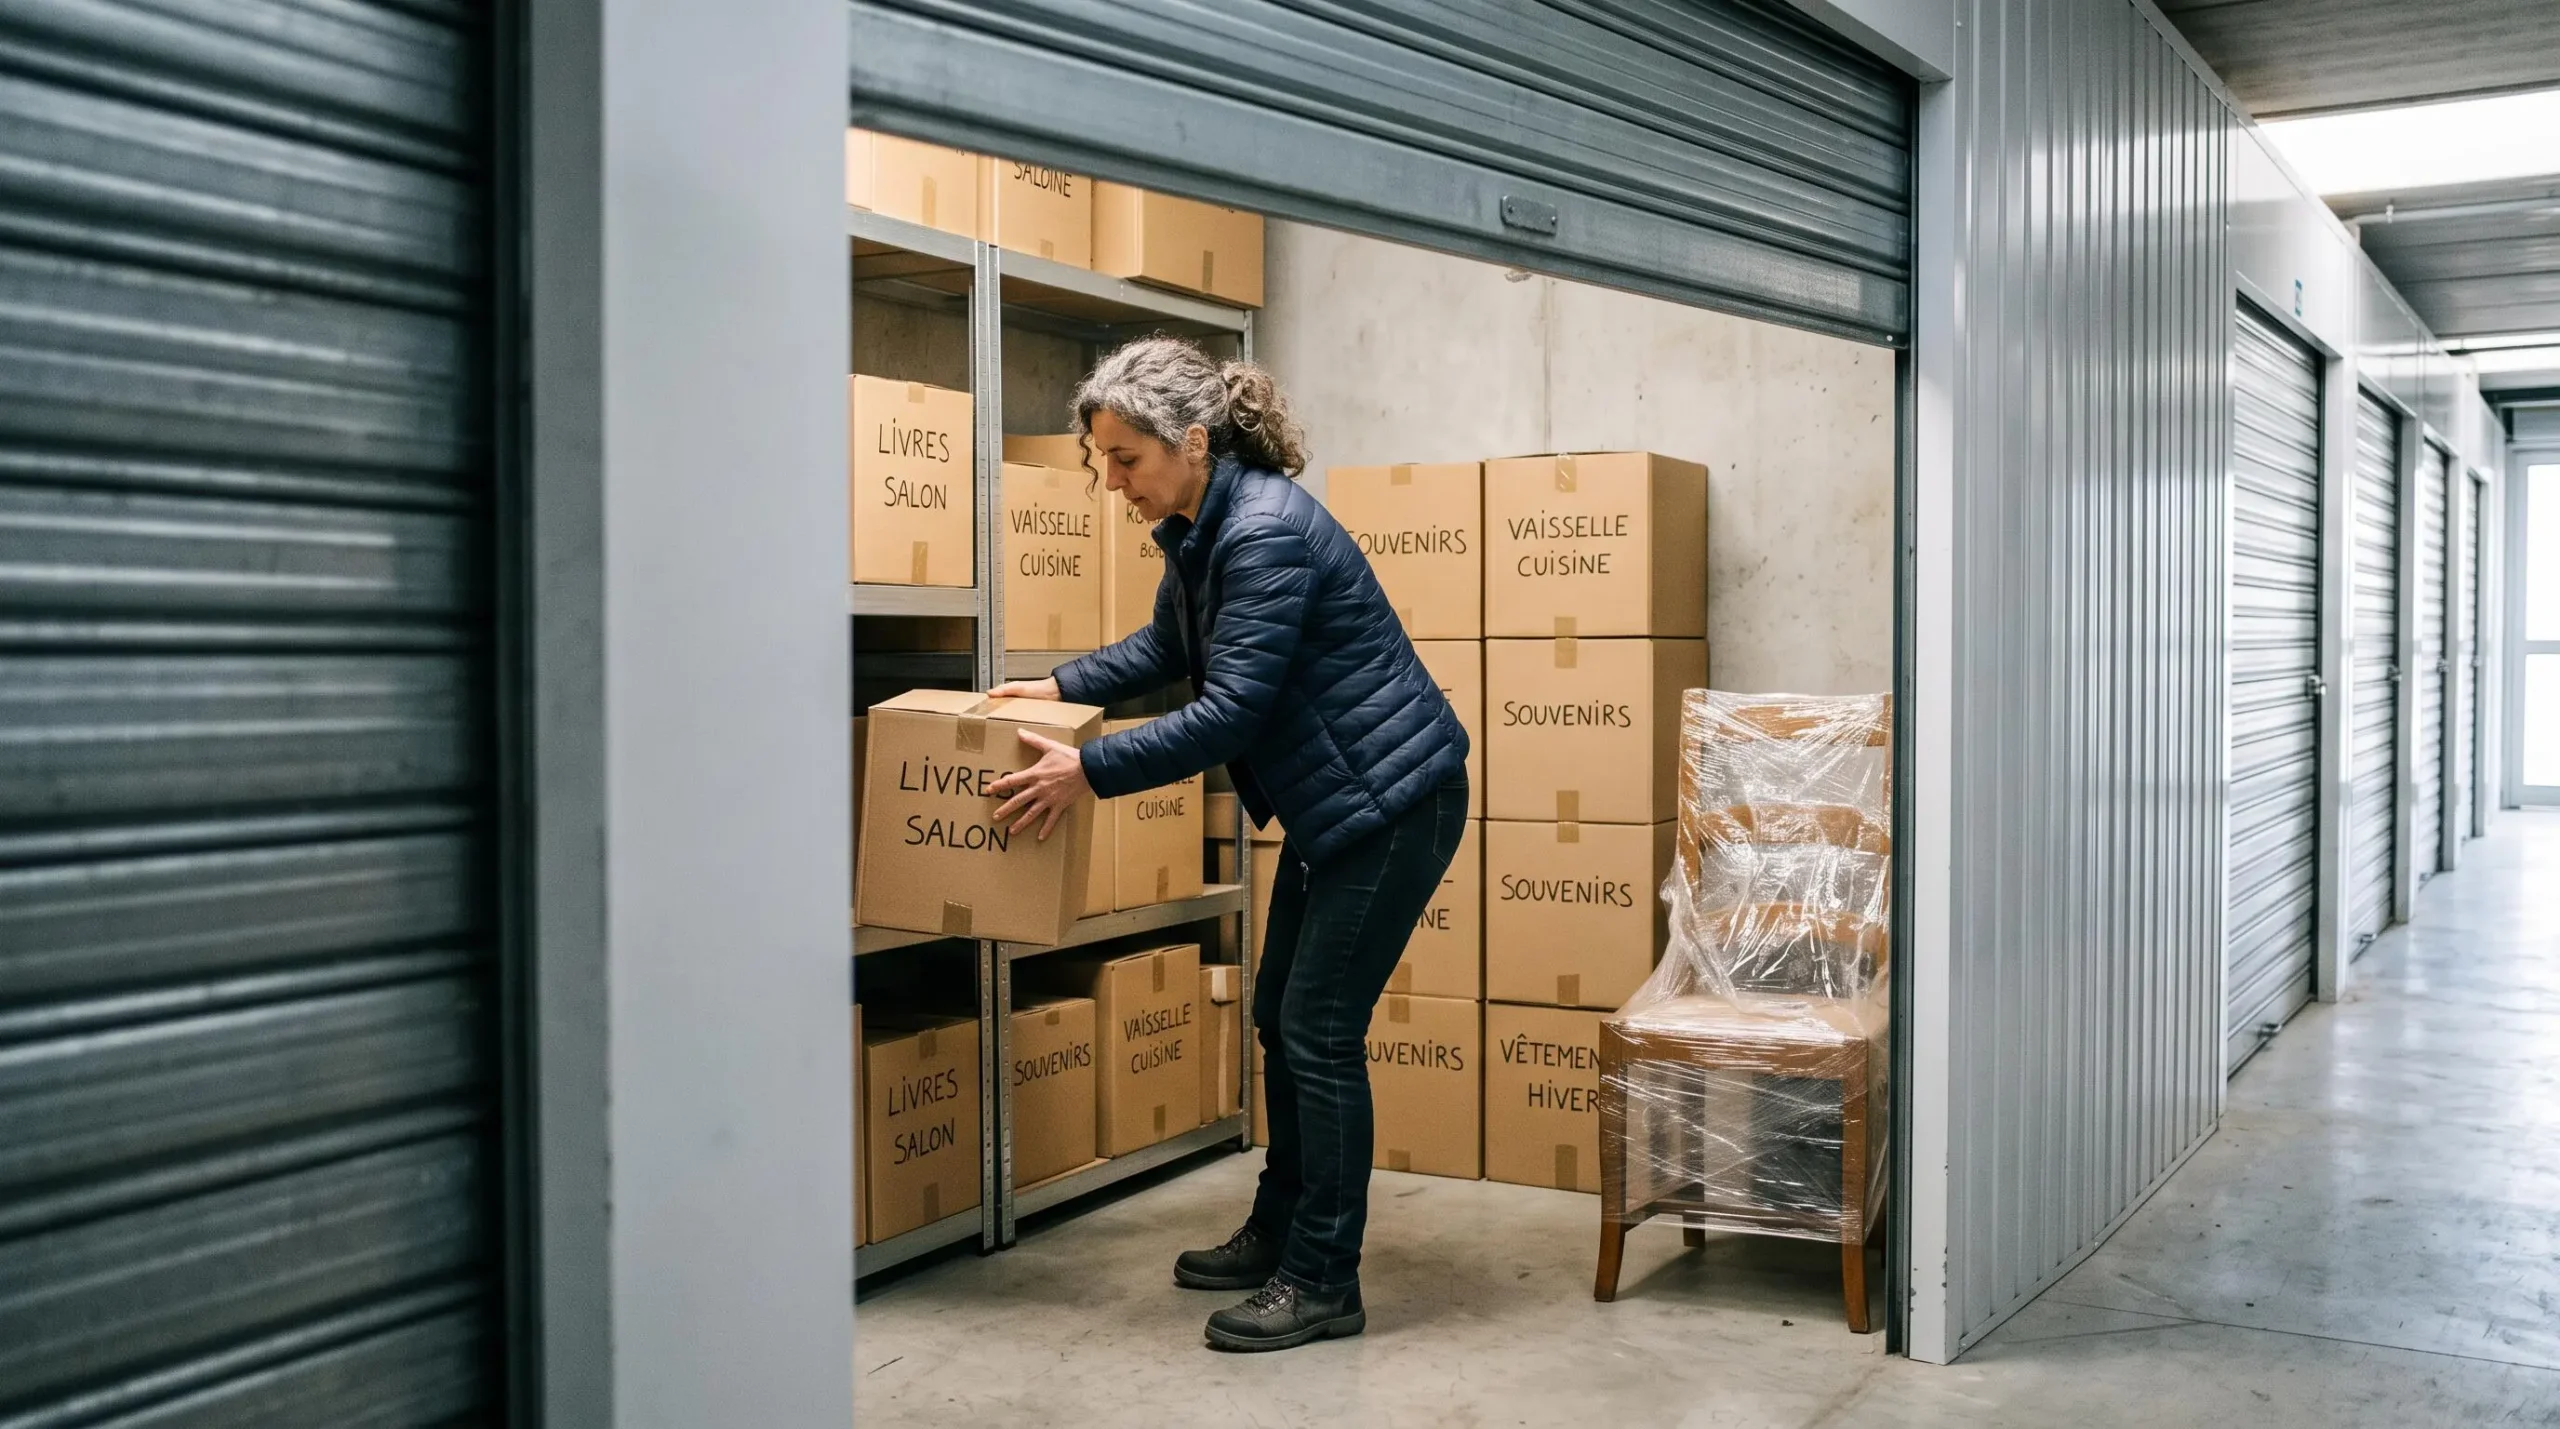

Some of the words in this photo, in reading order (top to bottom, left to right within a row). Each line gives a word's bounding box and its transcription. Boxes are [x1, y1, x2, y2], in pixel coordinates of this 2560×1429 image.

[885, 476, 946, 510] SALON
[1346, 525, 1467, 555] OUVENIRS
[904, 815, 1009, 853] SALON
[1369, 1040, 1464, 1071] UVENIRS
[1500, 1033, 1600, 1069] VÊTEMEN
[894, 1118, 954, 1164] SALON
